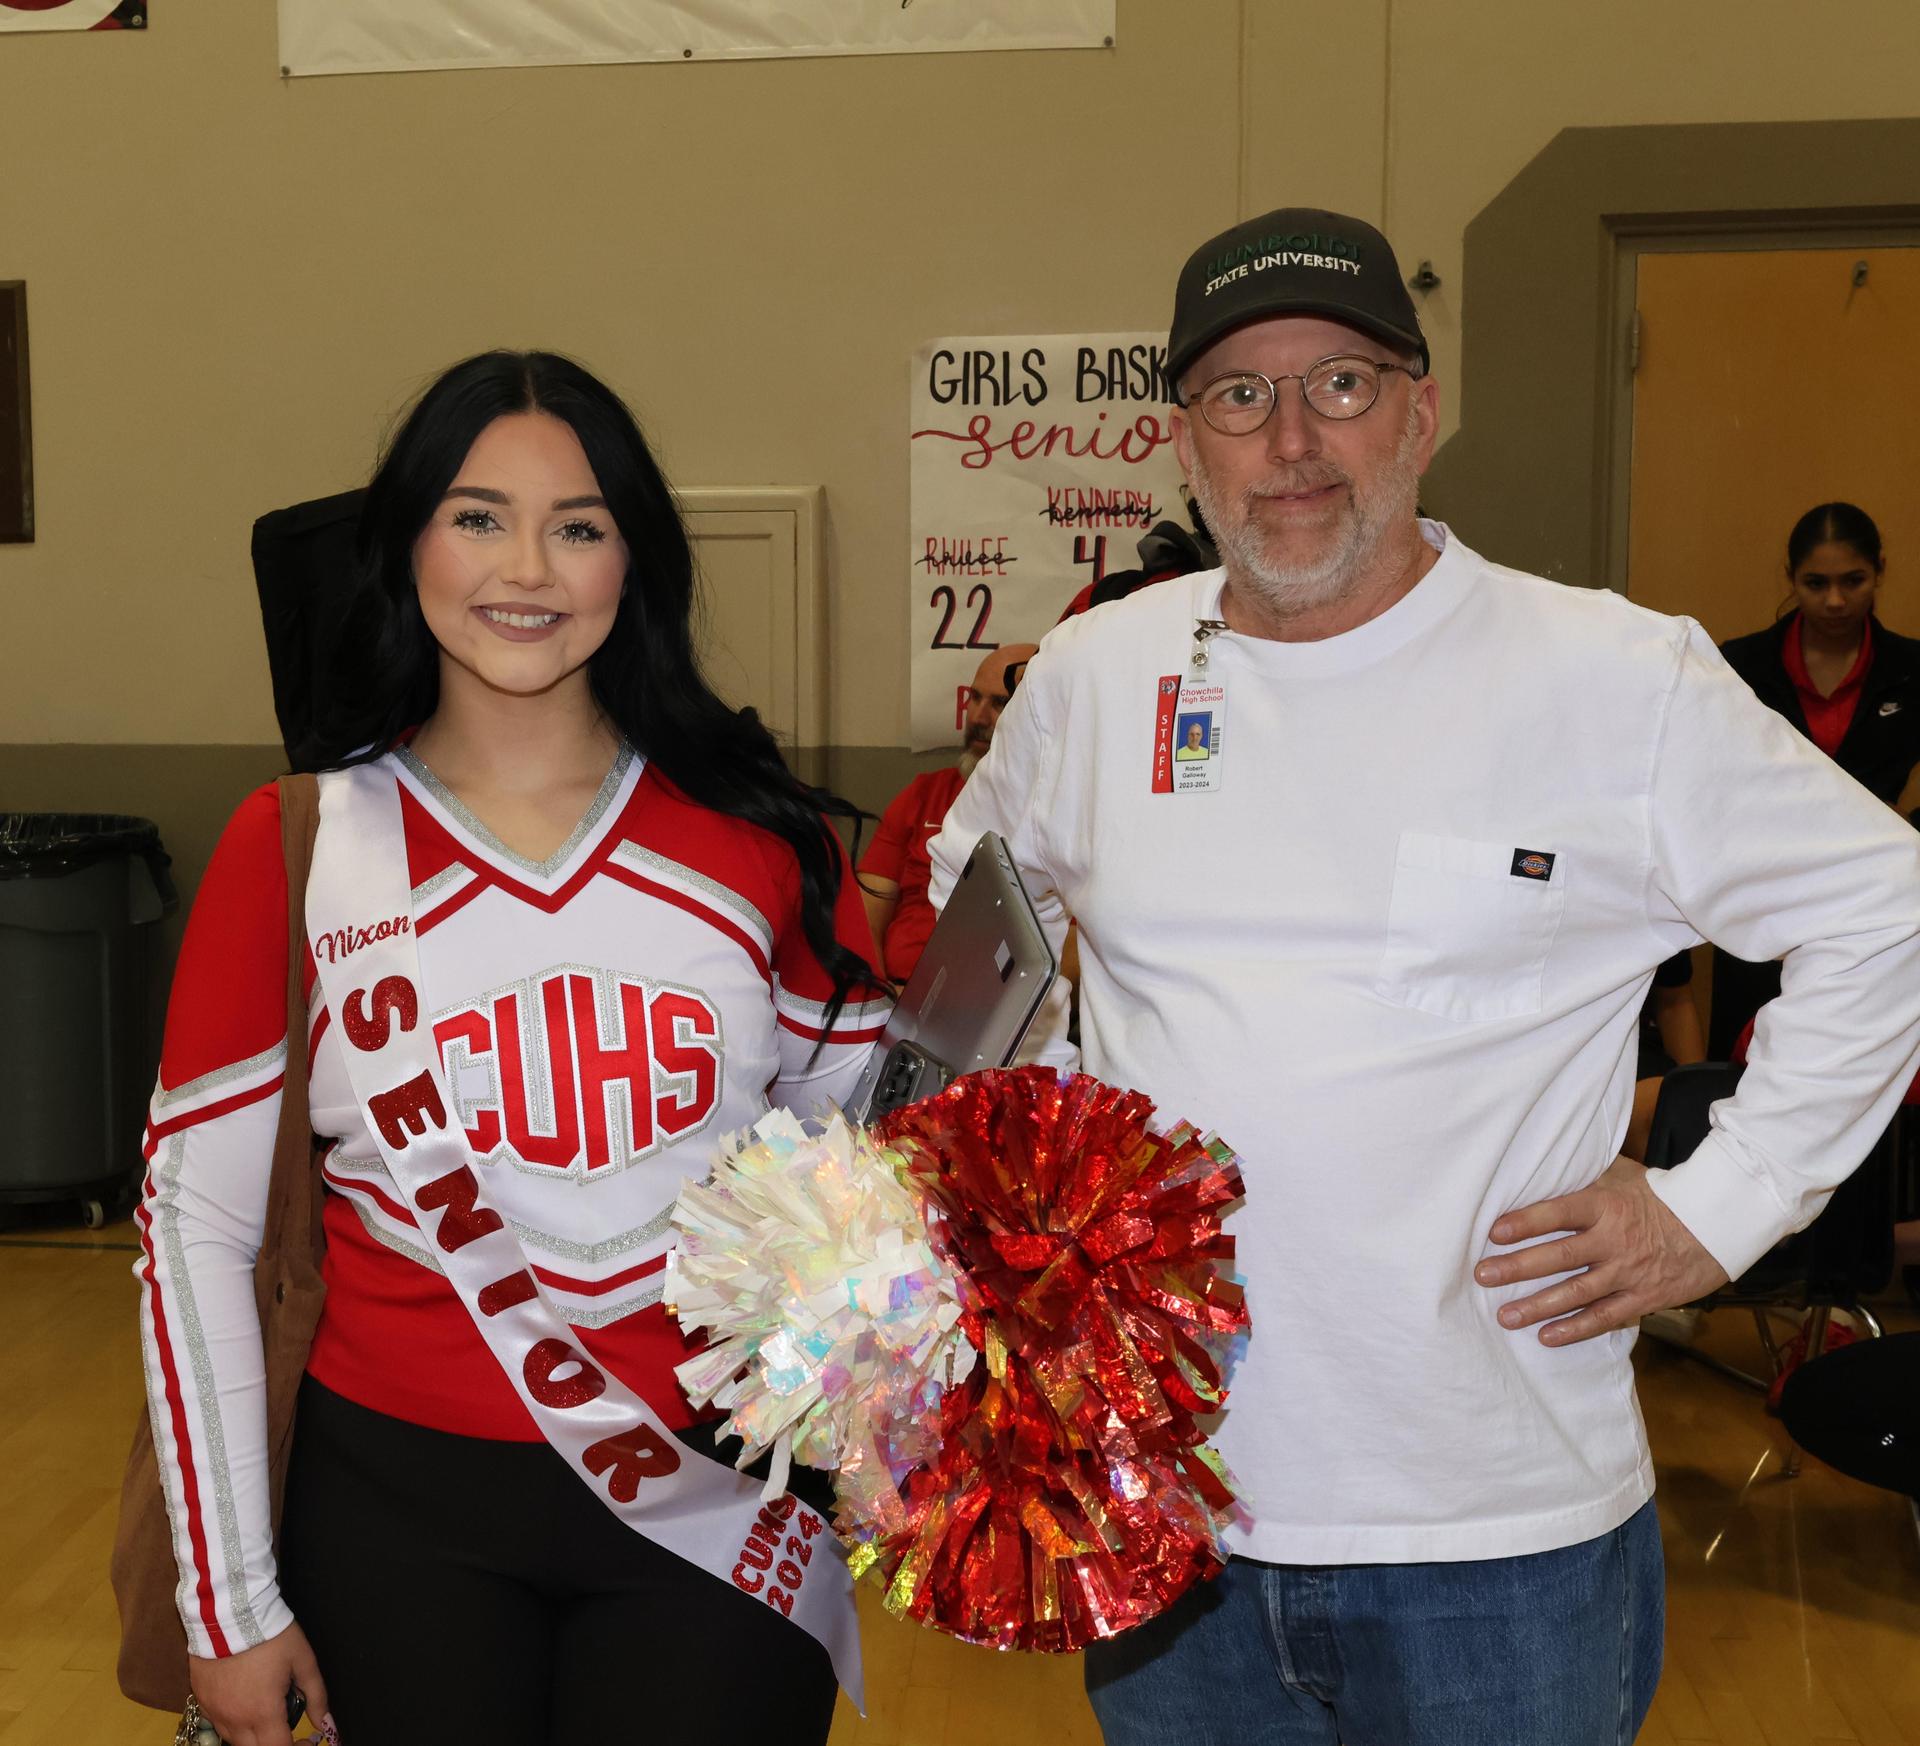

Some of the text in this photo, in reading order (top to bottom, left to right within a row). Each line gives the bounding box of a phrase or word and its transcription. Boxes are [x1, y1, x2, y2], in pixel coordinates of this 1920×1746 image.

[1205, 251, 1362, 296] STATE UNIVERSITY
[930, 344, 1175, 406] GIRLS BASK
[1073, 535, 1107, 584] 4
[930, 583, 1000, 650] 22
[1180, 687, 1224, 697] Chowchilla
[1182, 694, 1224, 705] High School
[1158, 714, 1168, 781] STAFF
[315, 915, 411, 964] Nixon
[432, 964, 723, 1182] CUHS
[342, 975, 681, 1503] SENIOR
[767, 1510, 823, 1617] 2024
